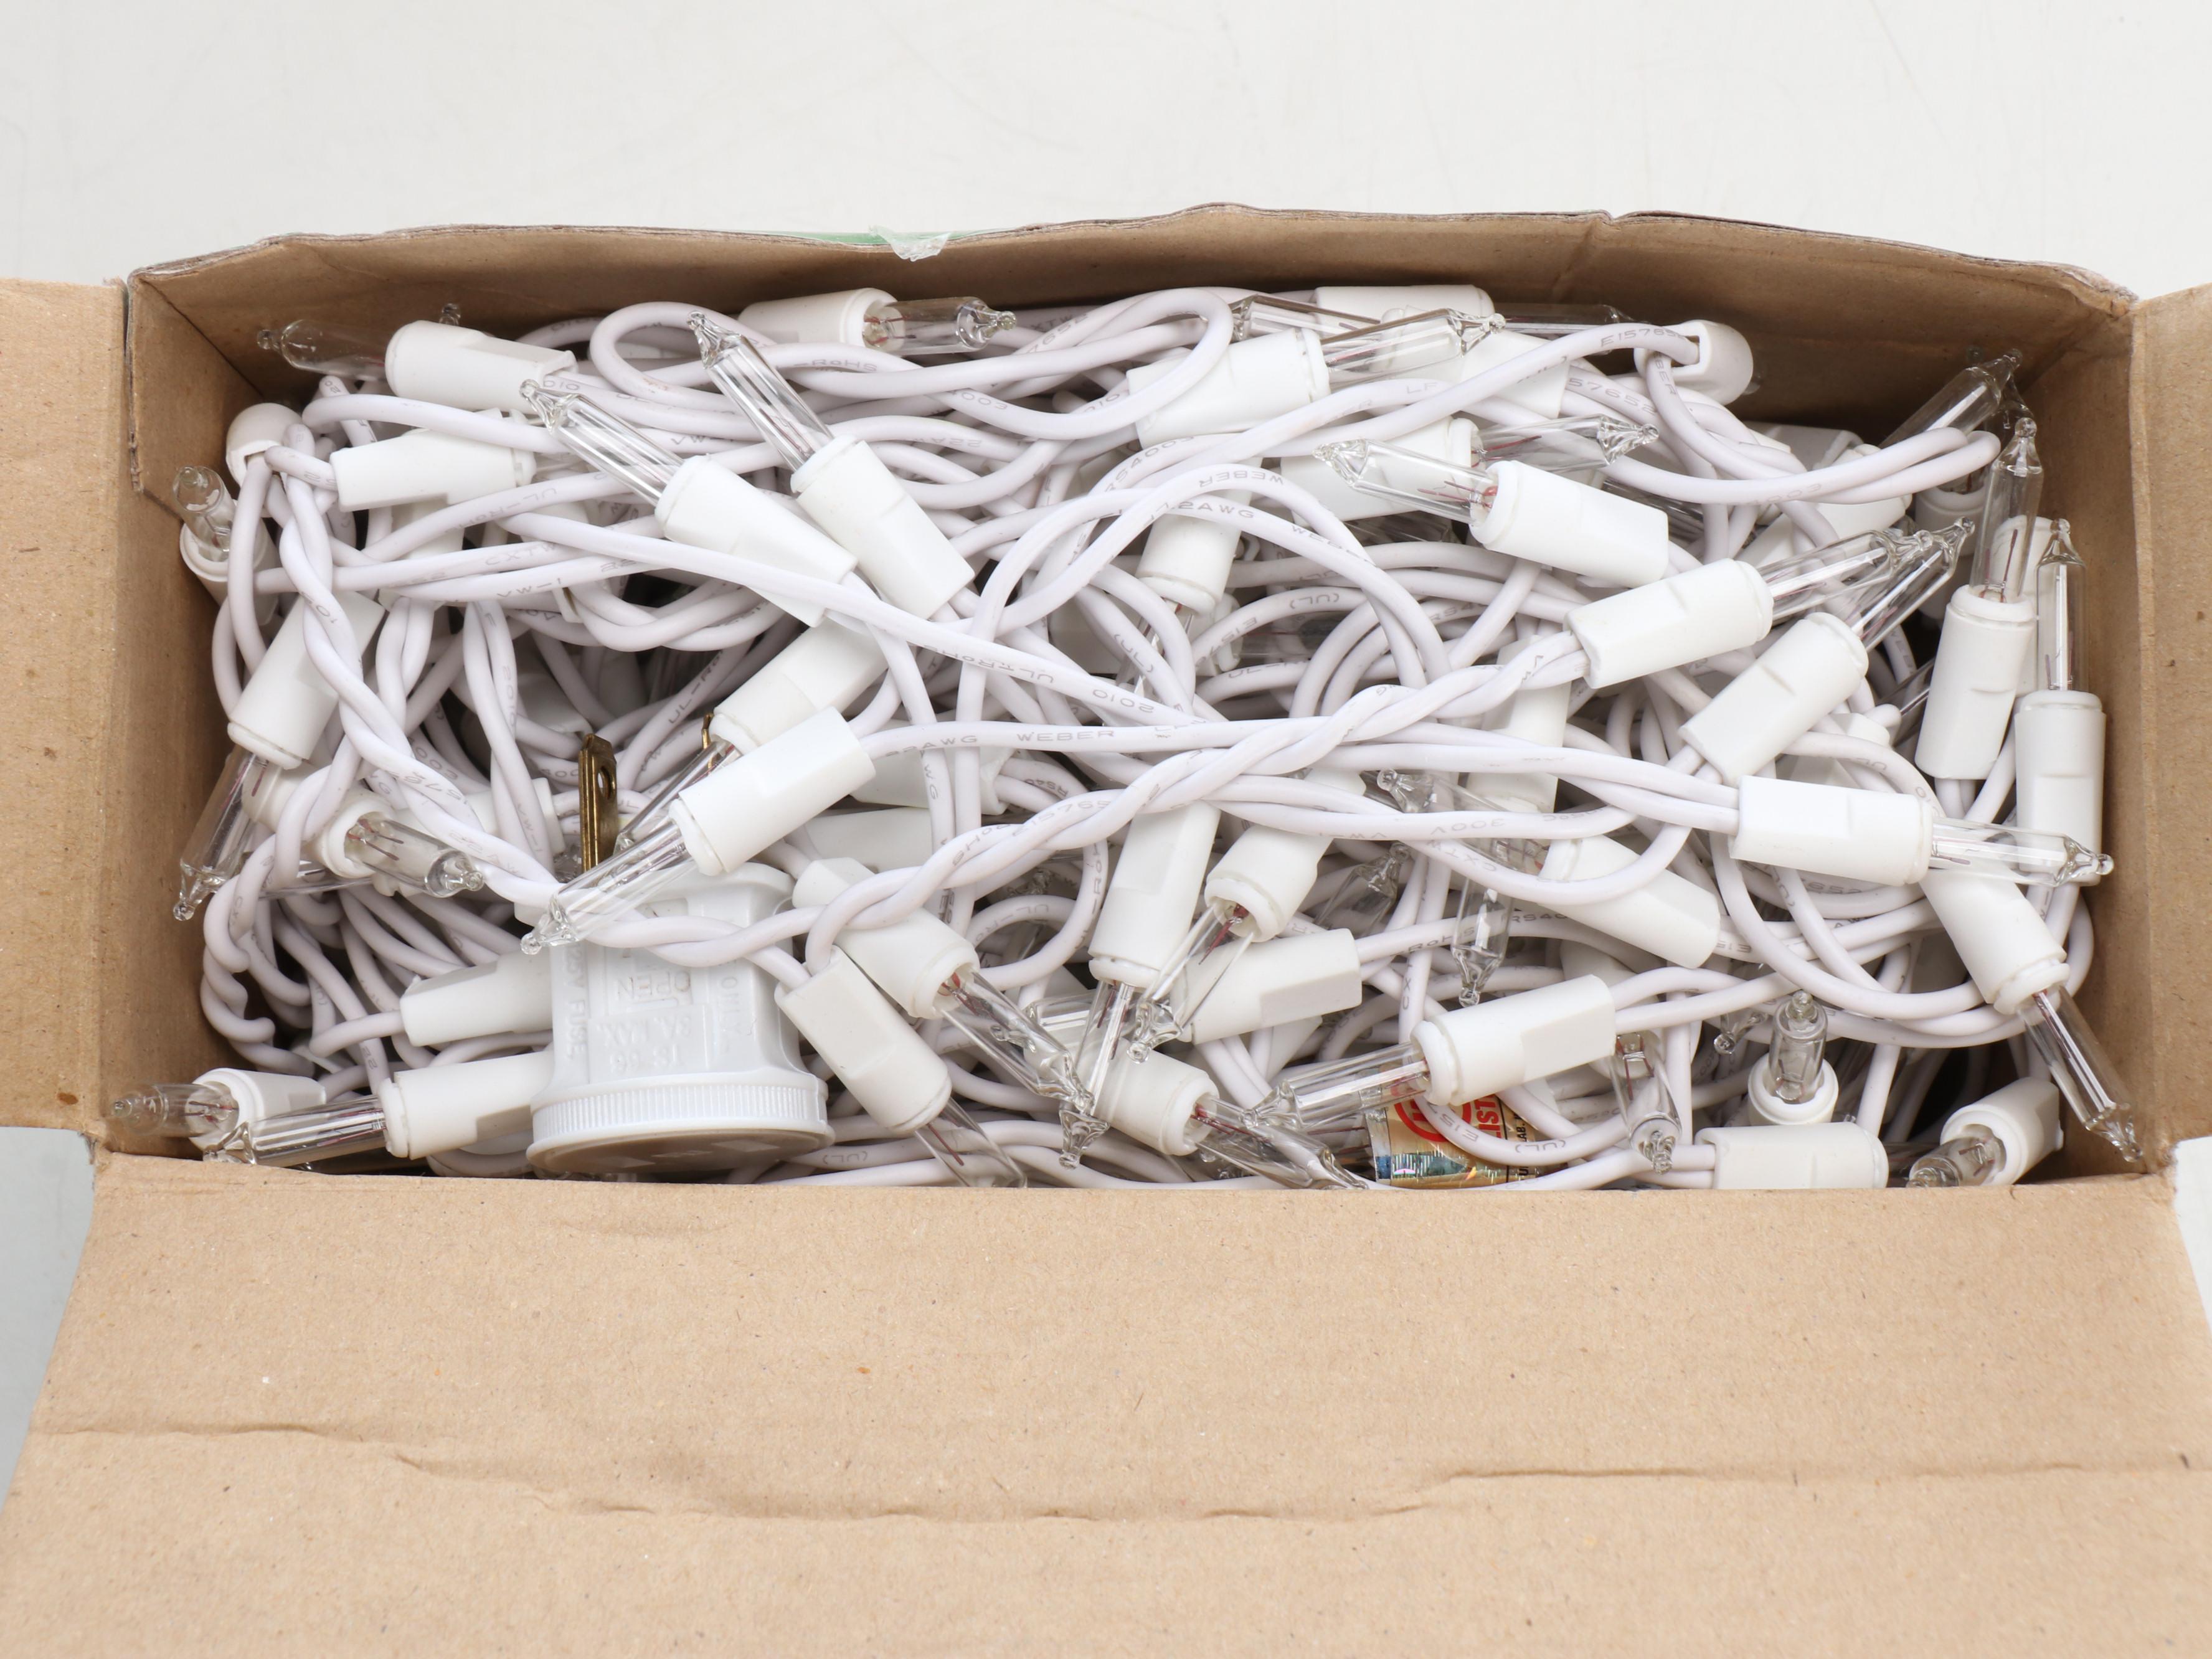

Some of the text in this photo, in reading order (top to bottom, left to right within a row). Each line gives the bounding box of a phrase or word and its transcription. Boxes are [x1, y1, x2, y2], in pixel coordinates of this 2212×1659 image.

[541, 379, 580, 392] 010
[1406, 382, 1438, 394] LF
[1198, 470, 1283, 486] WEBER
[1176, 500, 1255, 518] 2AWG
[495, 577, 562, 598] VW-1
[1288, 593, 1340, 609] (UL)
[1091, 688, 1155, 714] 2010
[1016, 730, 1115, 741] WEBER
[1430, 818, 1505, 834] 300V
[617, 971, 691, 1000] OPEN
[1473, 1094, 1502, 1139] LIST
[1514, 1140, 1565, 1153] (UL)
[821, 1151, 867, 1165] (UL)
